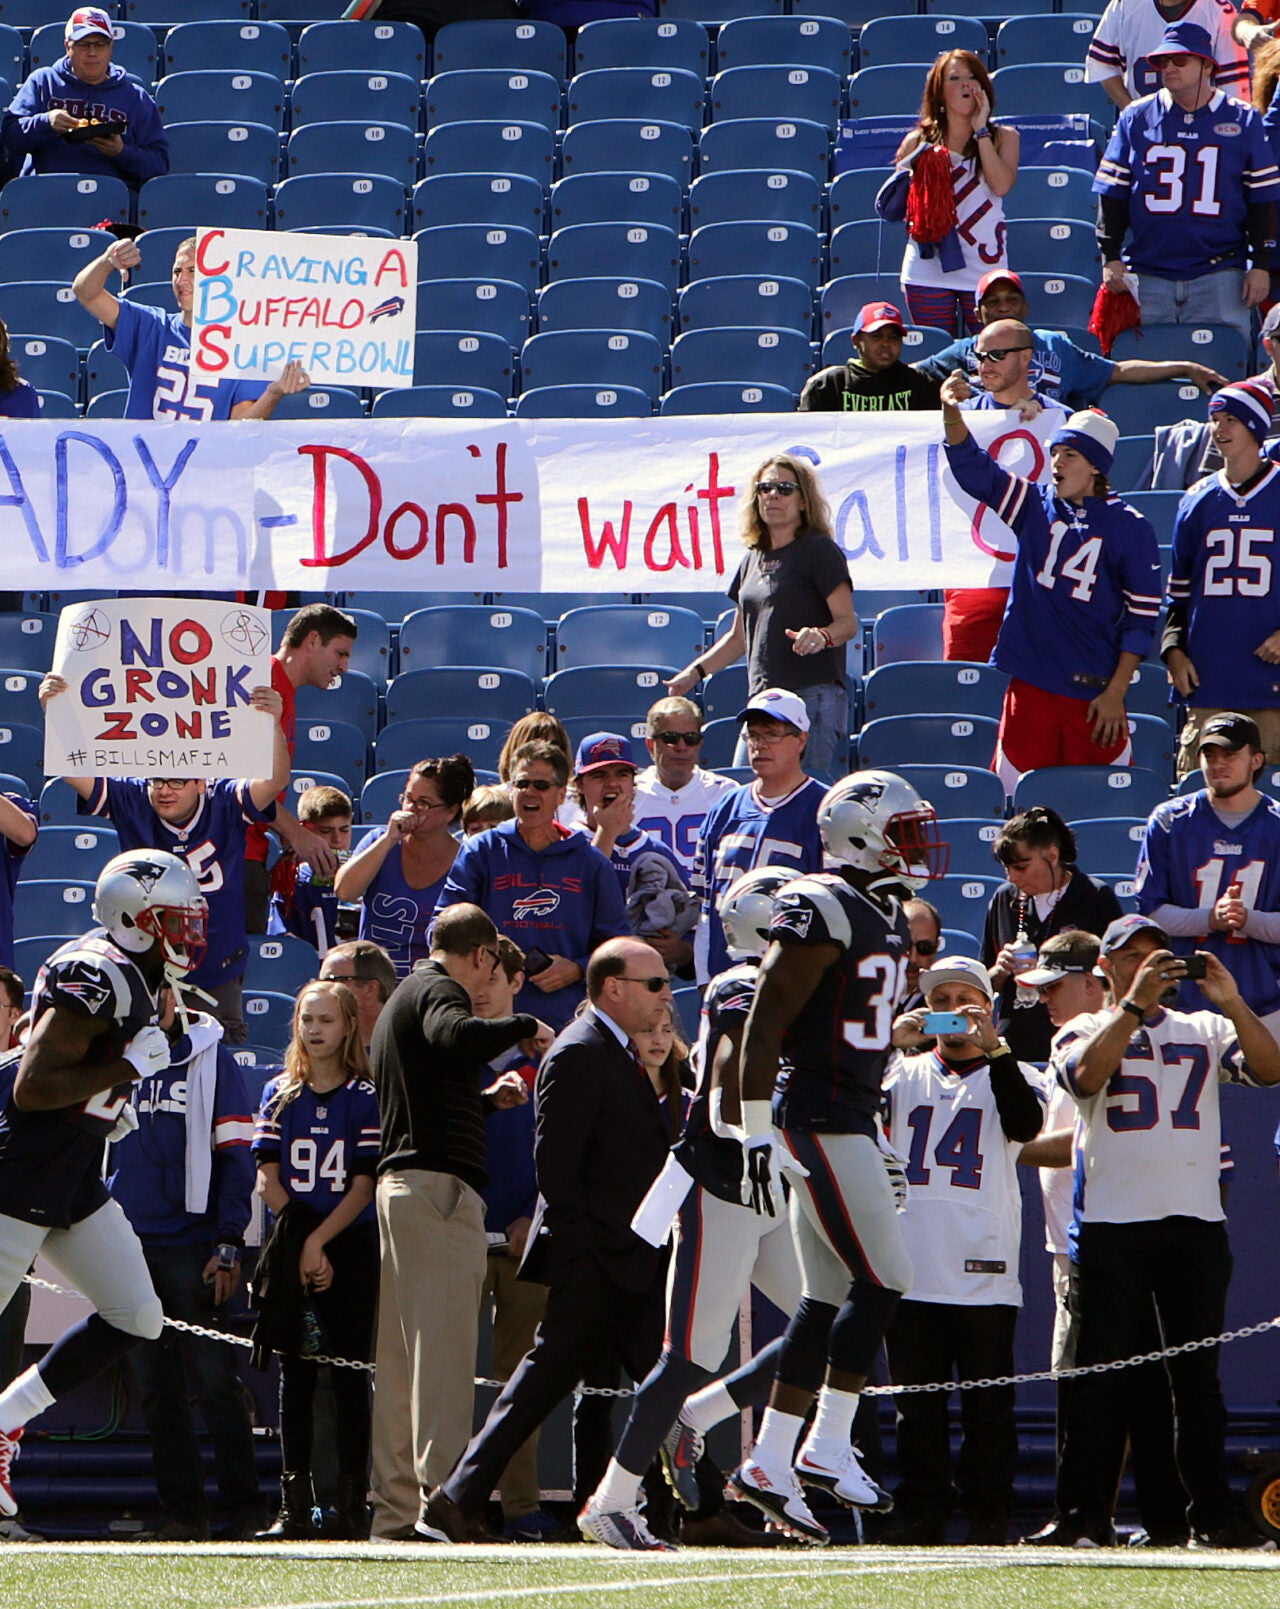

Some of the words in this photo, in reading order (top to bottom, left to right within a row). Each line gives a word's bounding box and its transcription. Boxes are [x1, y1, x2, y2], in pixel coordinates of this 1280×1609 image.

[1144, 144, 1221, 218] 31
[195, 230, 368, 287] CRAVING
[373, 248, 409, 288] A
[194, 276, 366, 330] BUFFALO
[152, 366, 221, 422] 25
[576, 451, 736, 577] wait
[785, 445, 943, 563] all
[1035, 519, 1105, 603] 14
[1203, 527, 1272, 598] 25
[120, 617, 213, 668] NO
[80, 665, 254, 709] GRONK
[94, 710, 232, 741] ZONE
[66, 749, 229, 769] #BILLSMAFIA
[493, 872, 583, 894] BILLS
[1193, 857, 1267, 945] 11
[1106, 1042, 1211, 1133] 57
[289, 1138, 347, 1193] 94
[905, 1104, 984, 1190] 14
[747, 1465, 774, 1491] NIKE
